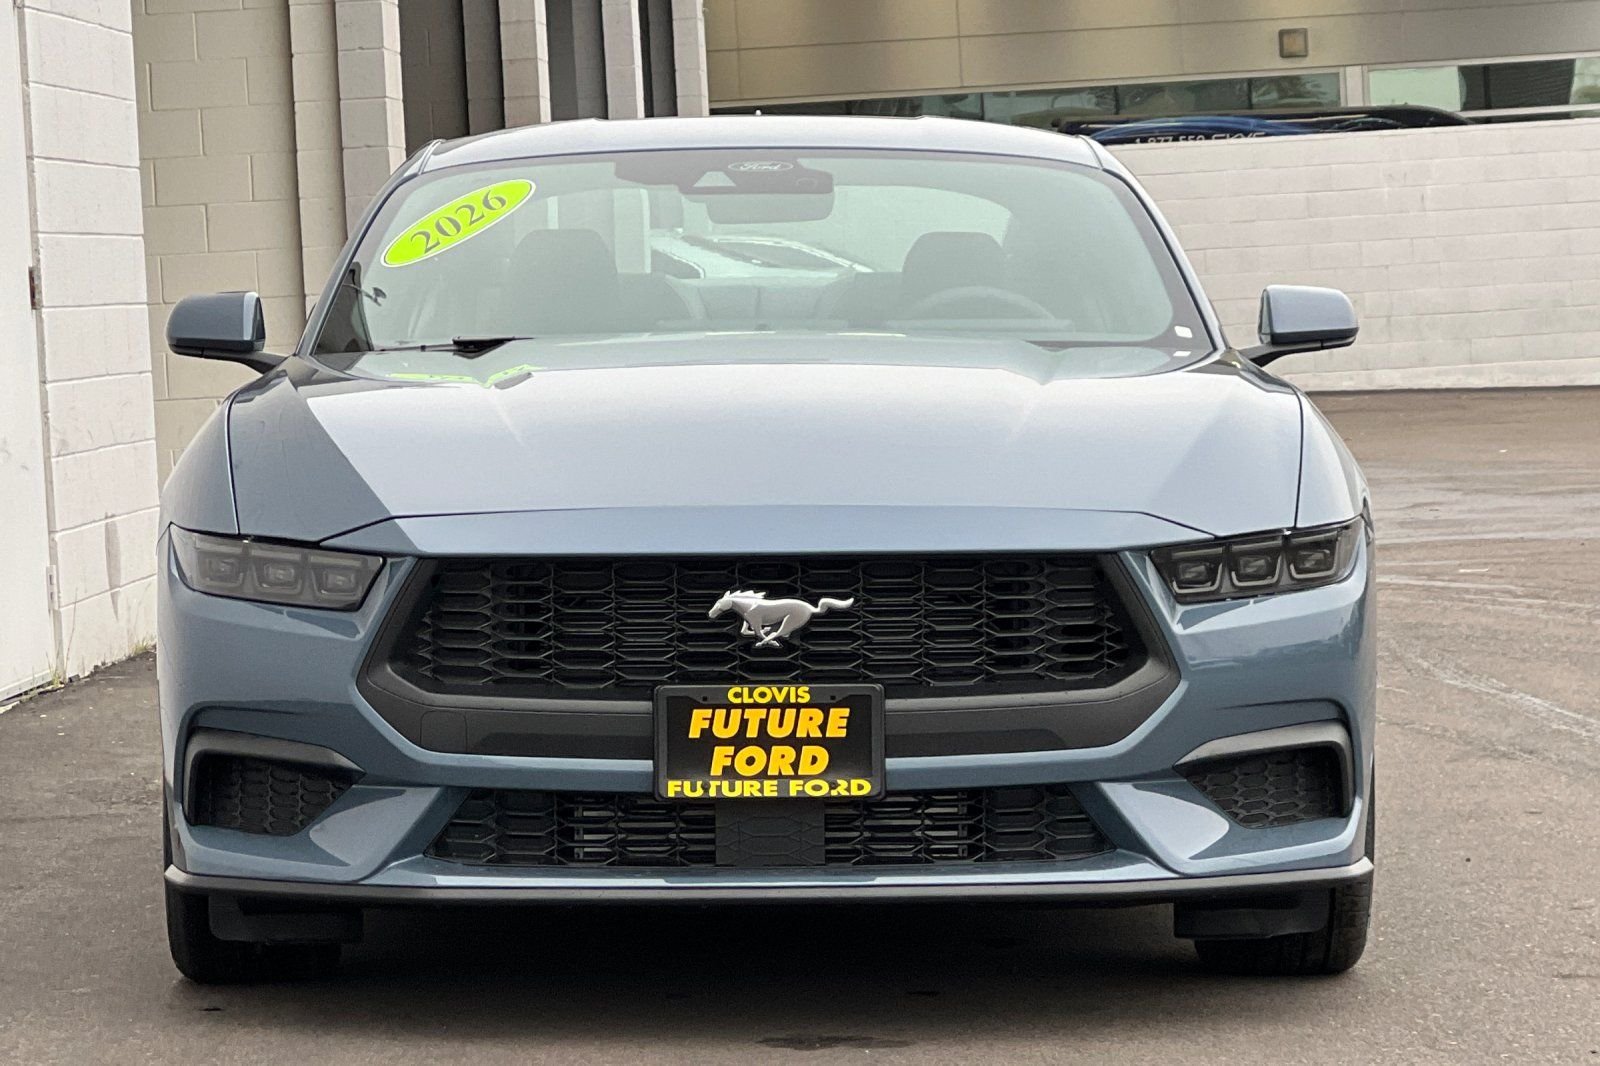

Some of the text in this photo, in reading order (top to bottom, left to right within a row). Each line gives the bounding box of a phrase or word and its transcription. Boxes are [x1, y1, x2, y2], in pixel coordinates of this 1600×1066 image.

[739, 160, 782, 171] Ford
[410, 190, 507, 254] 2026
[727, 686, 811, 704] CLOVIS
[688, 707, 851, 739] FUTURE
[710, 745, 830, 777] FORD
[667, 778, 872, 798] FUTURE FORD
